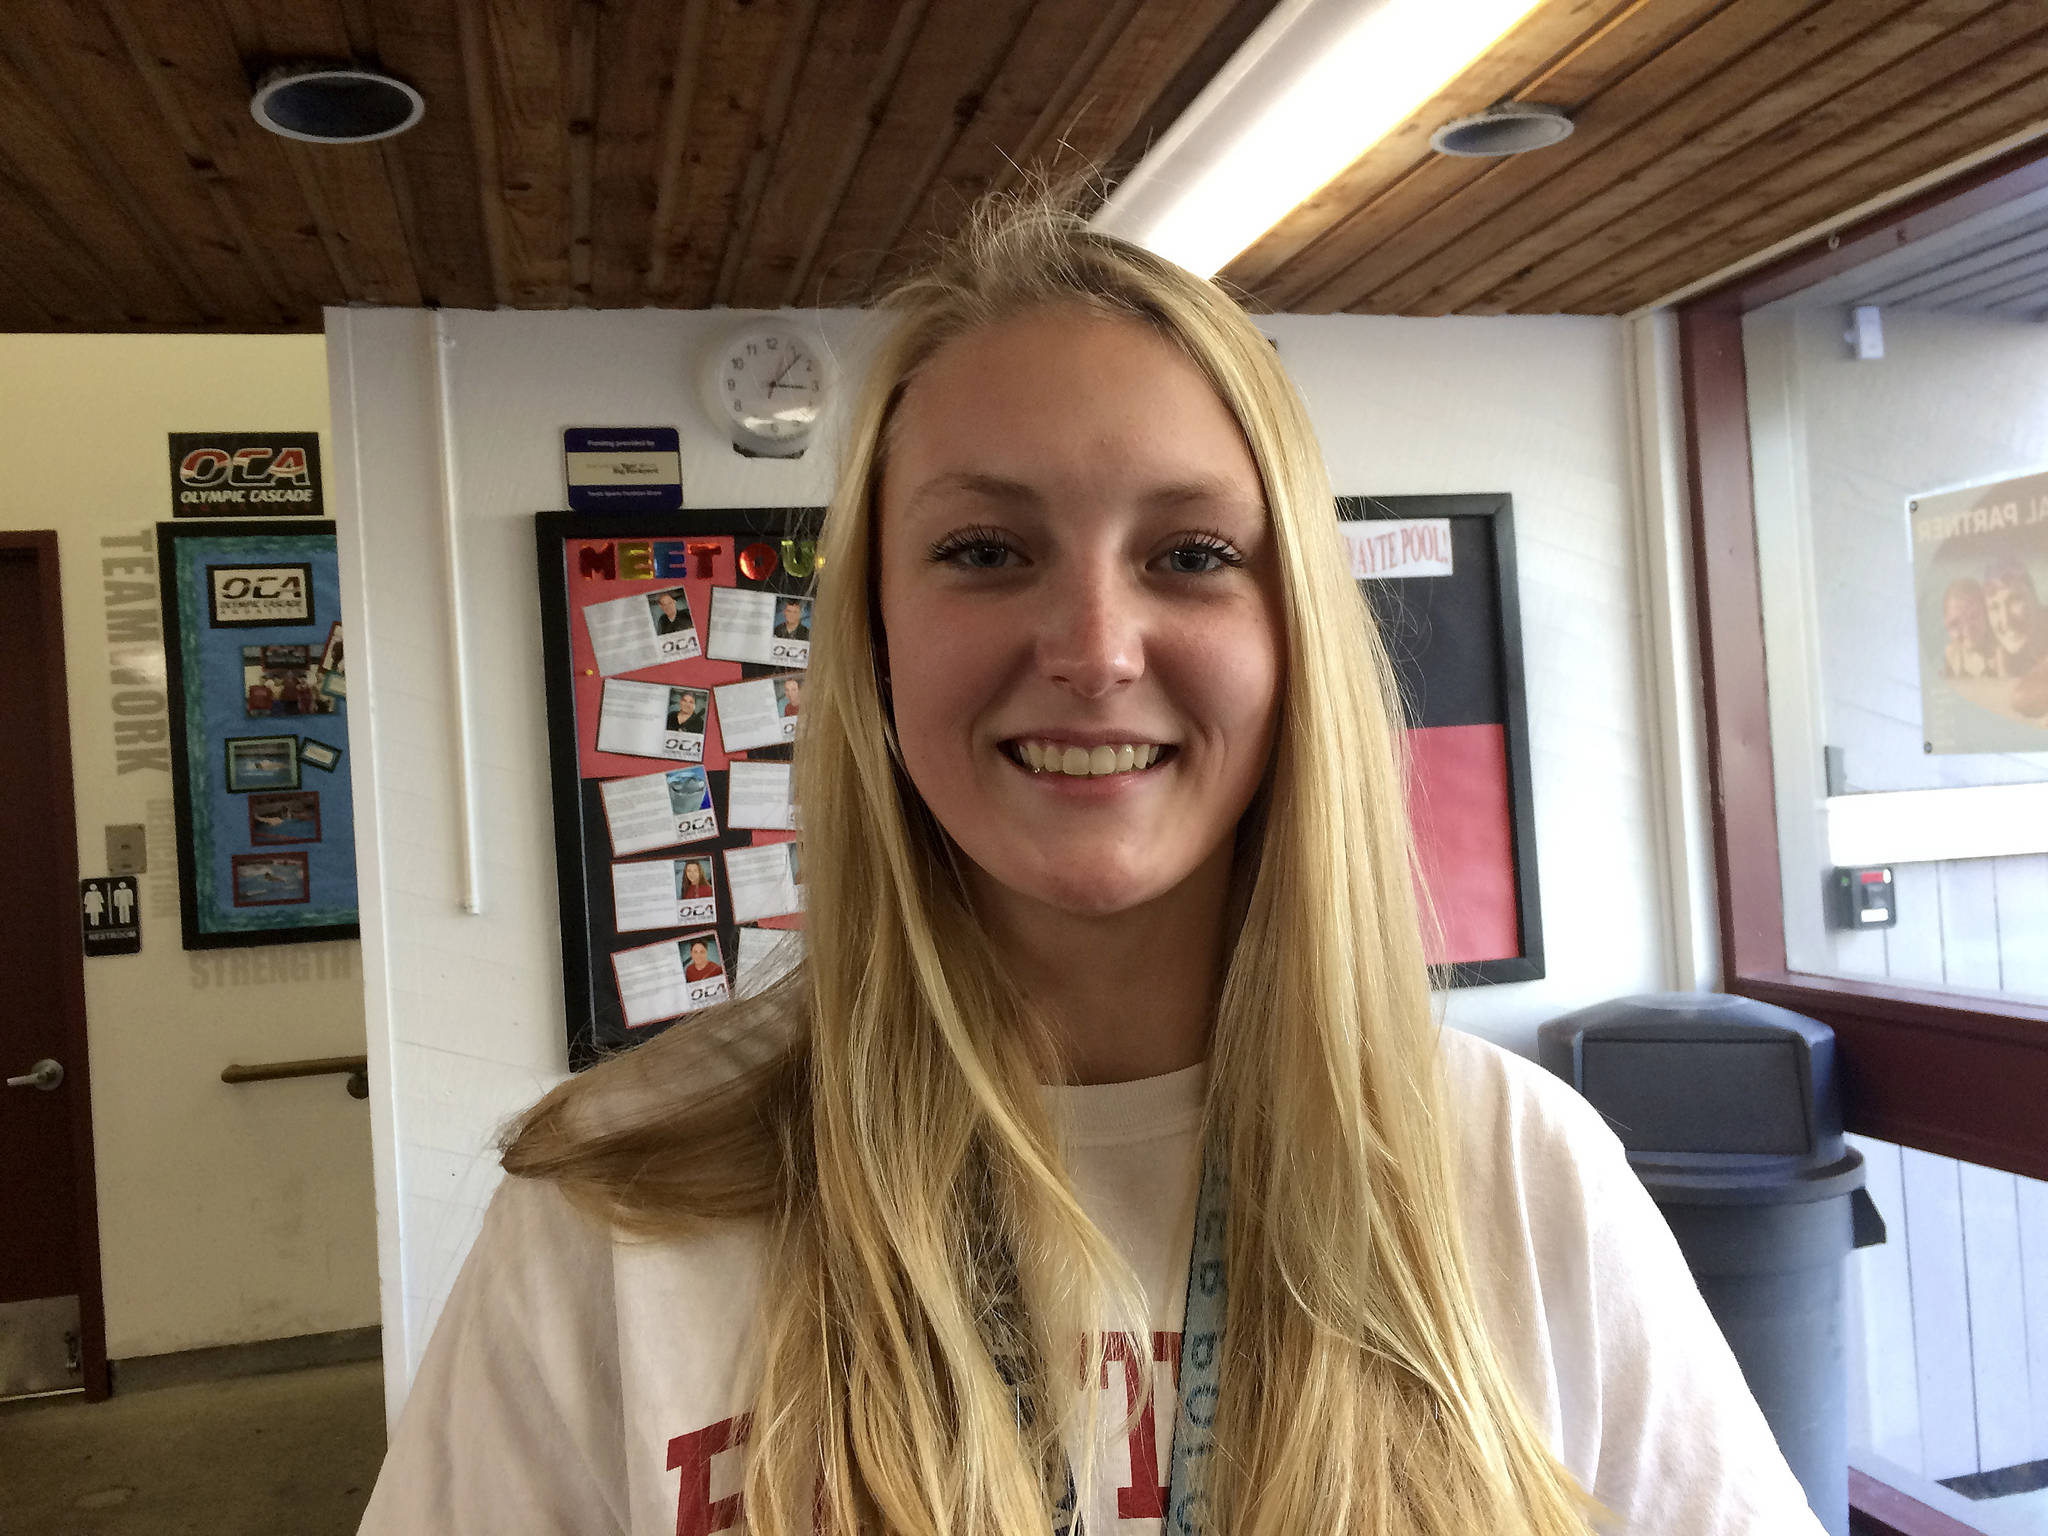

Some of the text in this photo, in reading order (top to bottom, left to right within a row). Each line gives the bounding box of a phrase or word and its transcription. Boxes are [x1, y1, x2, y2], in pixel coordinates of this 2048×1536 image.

[180, 448, 310, 487] OCA
[180, 488, 313, 504] OLYMPIC CASCADE
[579, 540, 820, 581] MEET OU
[221, 576, 301, 599] OCA
[662, 636, 698, 653] OCA
[773, 645, 808, 660] OCA
[665, 738, 702, 754] OCA
[678, 816, 715, 832] OCA
[679, 904, 714, 918] OCA
[87, 930, 136, 942] RESTROOM
[190, 943, 351, 989] STRENGTH
[691, 982, 727, 1001] OCA
